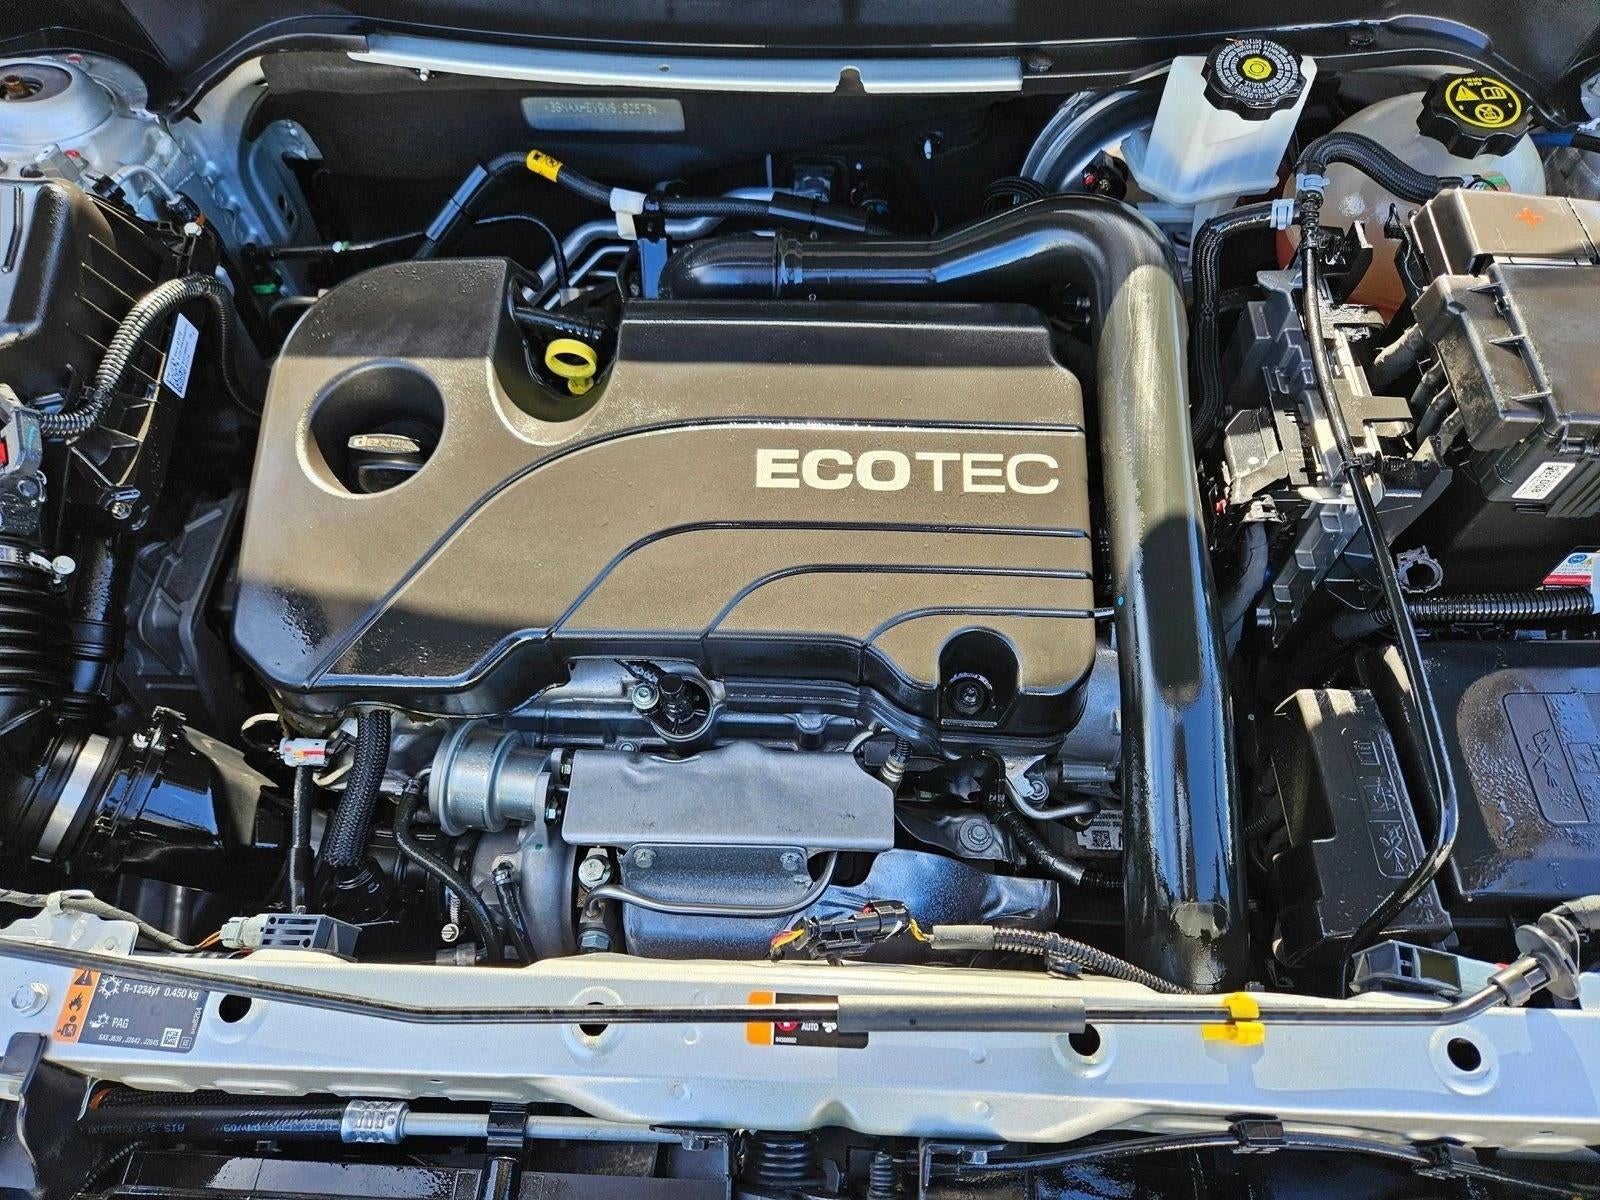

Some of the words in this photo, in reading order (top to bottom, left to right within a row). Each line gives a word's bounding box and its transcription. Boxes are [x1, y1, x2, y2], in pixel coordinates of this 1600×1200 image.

[756, 448, 1059, 494] ECOTEC
[123, 984, 160, 996] R-1234yf
[164, 987, 187, 997] 0.450
[188, 989, 199, 1000] kg
[112, 1018, 129, 1029] PAG
[801, 1022, 819, 1031] AUTO
